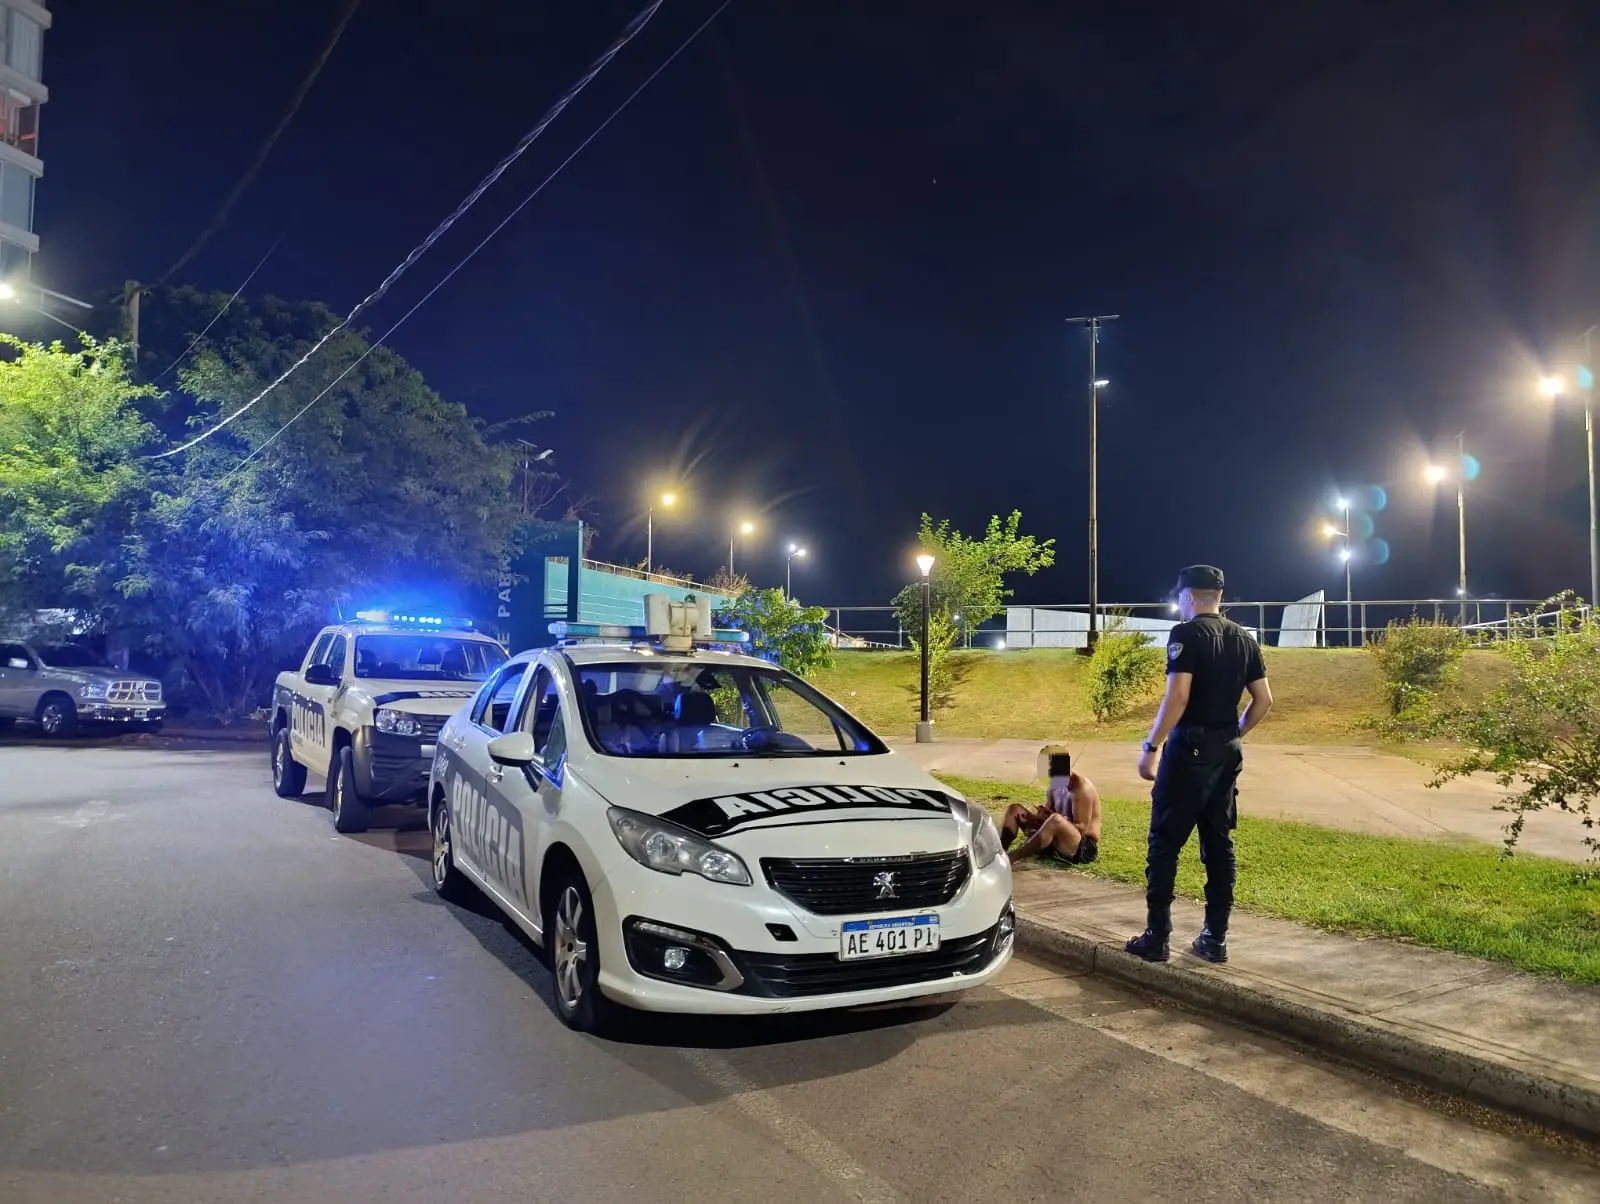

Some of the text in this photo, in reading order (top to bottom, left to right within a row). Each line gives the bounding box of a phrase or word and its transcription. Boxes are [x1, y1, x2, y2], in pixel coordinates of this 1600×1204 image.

[292, 701, 325, 747] POLICIA
[453, 771, 526, 904] POLICIA
[847, 933, 869, 954] AE
[876, 929, 907, 951] 401
